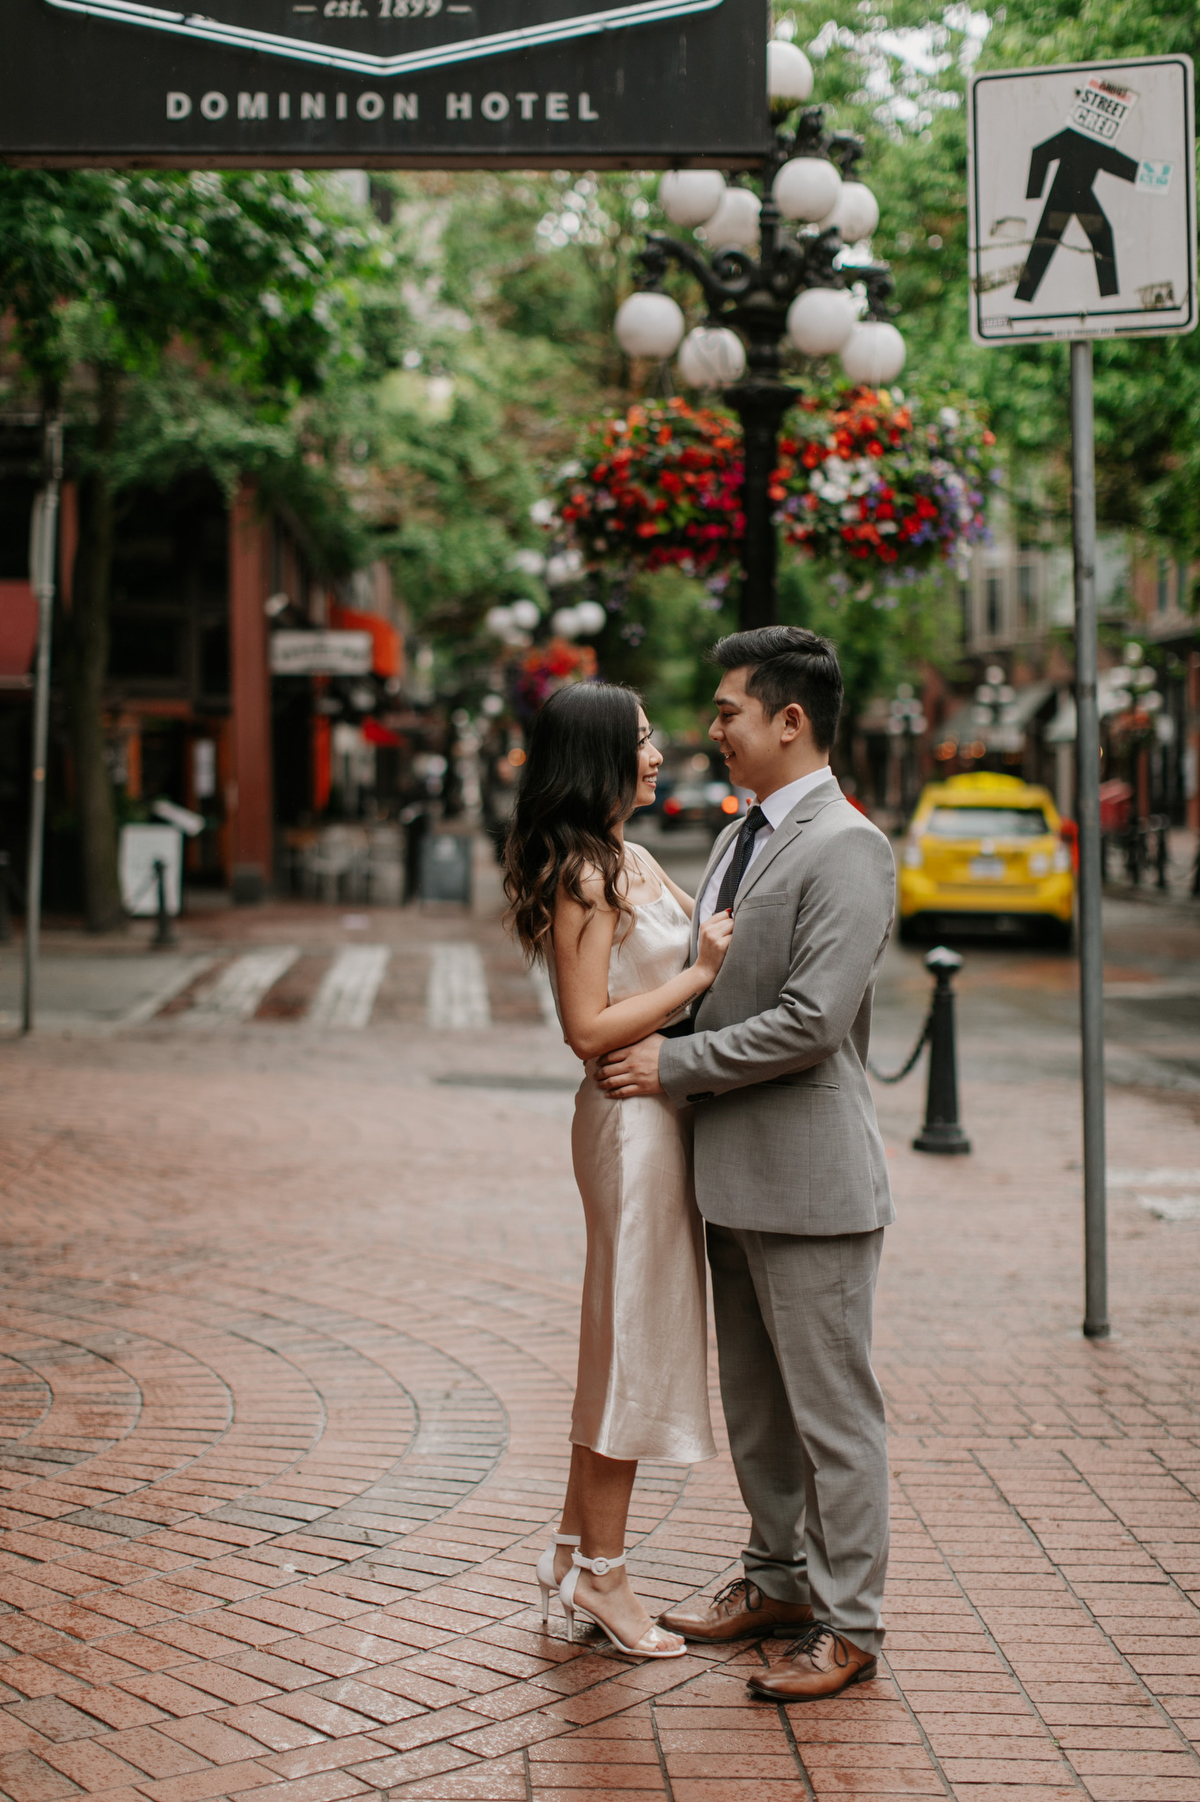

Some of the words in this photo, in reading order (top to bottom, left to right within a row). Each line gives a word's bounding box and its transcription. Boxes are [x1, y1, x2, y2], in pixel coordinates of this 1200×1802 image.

[323, 0, 369, 18] est.
[378, 0, 442, 18] 1899
[166, 91, 419, 121] DOMINION
[446, 91, 600, 121] HOTEL
[1081, 89, 1128, 119] STREET
[1072, 105, 1120, 139] CRED
